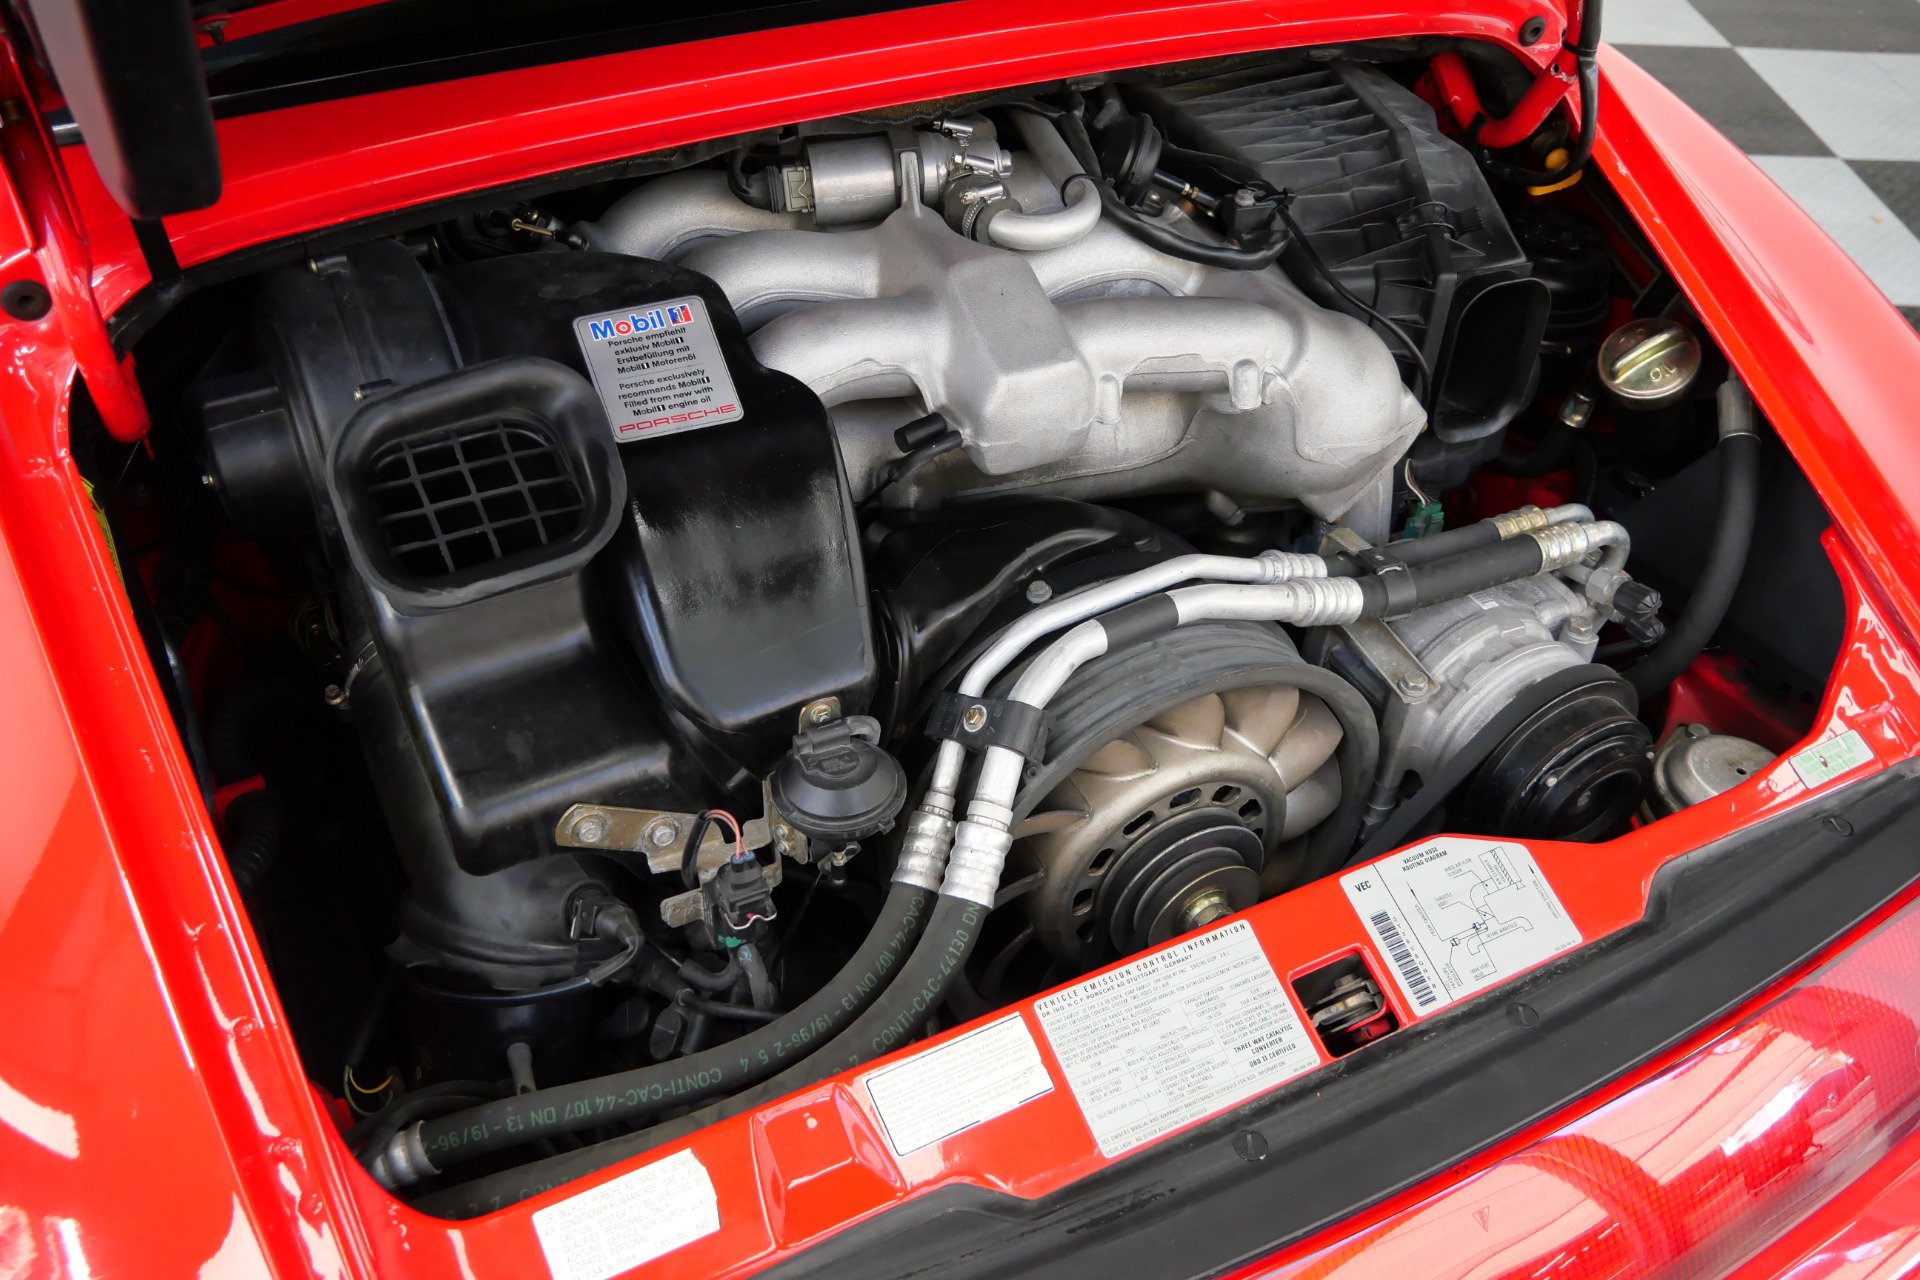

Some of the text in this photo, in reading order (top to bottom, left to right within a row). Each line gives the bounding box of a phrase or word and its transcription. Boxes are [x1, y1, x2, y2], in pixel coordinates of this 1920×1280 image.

[589, 304, 694, 341] Mobil 1
[608, 327, 687, 347] Porsche empfiehlt
[614, 344, 650, 356] exklusiv
[617, 348, 675, 365] Erstbefüllung
[652, 354, 696, 367] Motorenöl
[619, 368, 706, 390] Porsche exclusively
[618, 384, 676, 400] recommends
[624, 398, 648, 408] Filled
[650, 394, 671, 403] from
[694, 386, 713, 394] with
[668, 399, 698, 410] engine
[619, 404, 736, 433] PORSCHE
[1402, 850, 1447, 872] ROUTING DIAGRAM
[1403, 853, 1424, 864] VACUUM
[1355, 880, 1372, 892] VEC
[961, 901, 982, 927] DN
[1038, 990, 1078, 1010] VEHICLE
[1084, 970, 1131, 992] EMISSION
[1136, 951, 1178, 971] CONTROL
[1183, 924, 1246, 952] INFORMATION
[1087, 986, 1115, 999] PORSCHE
[1126, 968, 1160, 984] STUTTGART
[1164, 955, 1193, 968] GERMANY
[854, 971, 878, 997] DN
[840, 991, 859, 1012] 13
[1234, 1024, 1292, 1053] THREE WAY CATALYTIC
[1251, 1037, 1283, 1054] CONVERTER
[1249, 1058, 1262, 1067] OBD
[1269, 1043, 1296, 1058] CERTIFIED
[505, 1115, 525, 1133] 13
[528, 1105, 557, 1127] DN
